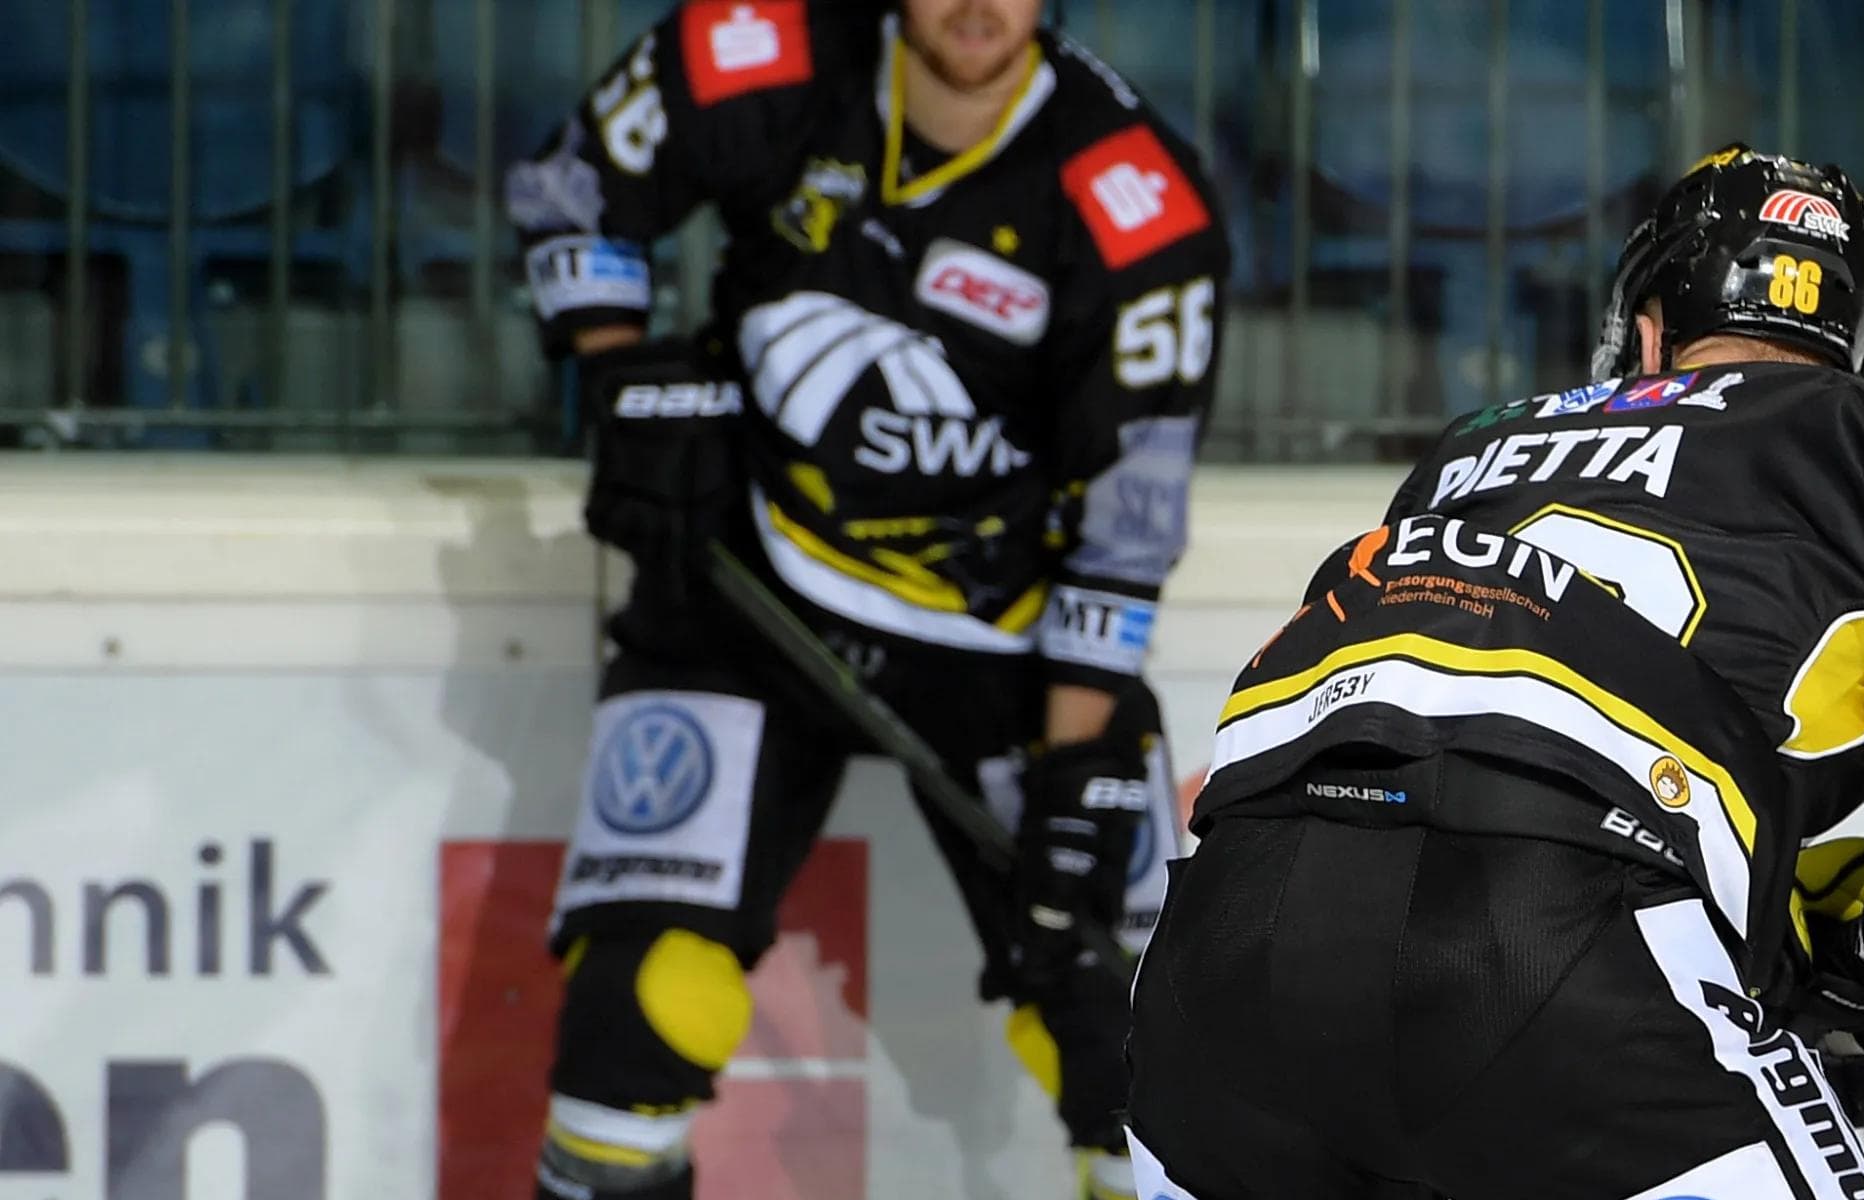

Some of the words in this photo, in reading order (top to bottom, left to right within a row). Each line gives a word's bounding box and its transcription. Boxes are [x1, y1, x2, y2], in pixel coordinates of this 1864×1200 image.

[1769, 254, 1823, 315] 86
[1427, 425, 1684, 512] PIETTA
[1386, 514, 1576, 603] EGN
[1457, 597, 1495, 619] mbH
